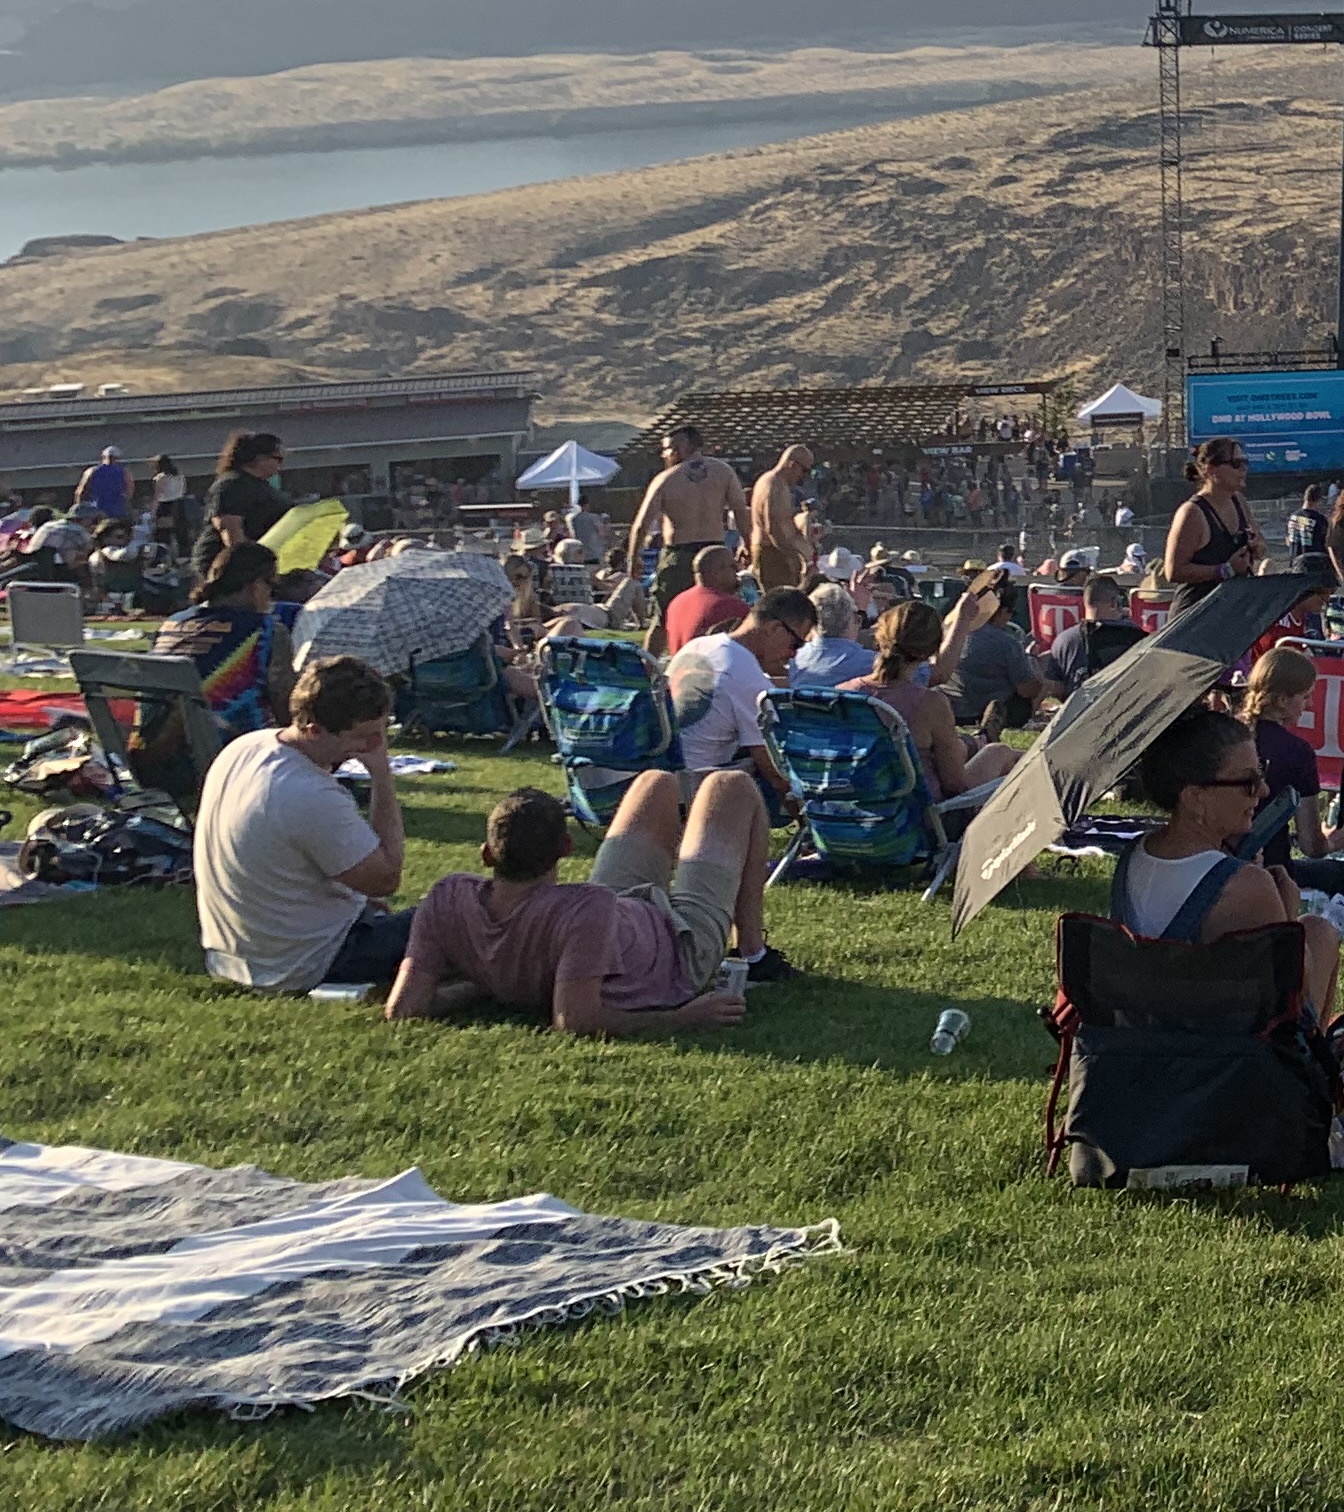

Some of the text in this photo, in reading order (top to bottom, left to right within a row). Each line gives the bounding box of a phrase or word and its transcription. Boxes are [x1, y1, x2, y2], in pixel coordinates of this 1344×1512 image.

[1228, 26, 1285, 36] NUMERICA
[1293, 24, 1333, 33] CONCERT
[1234, 414, 1247, 422] AT
